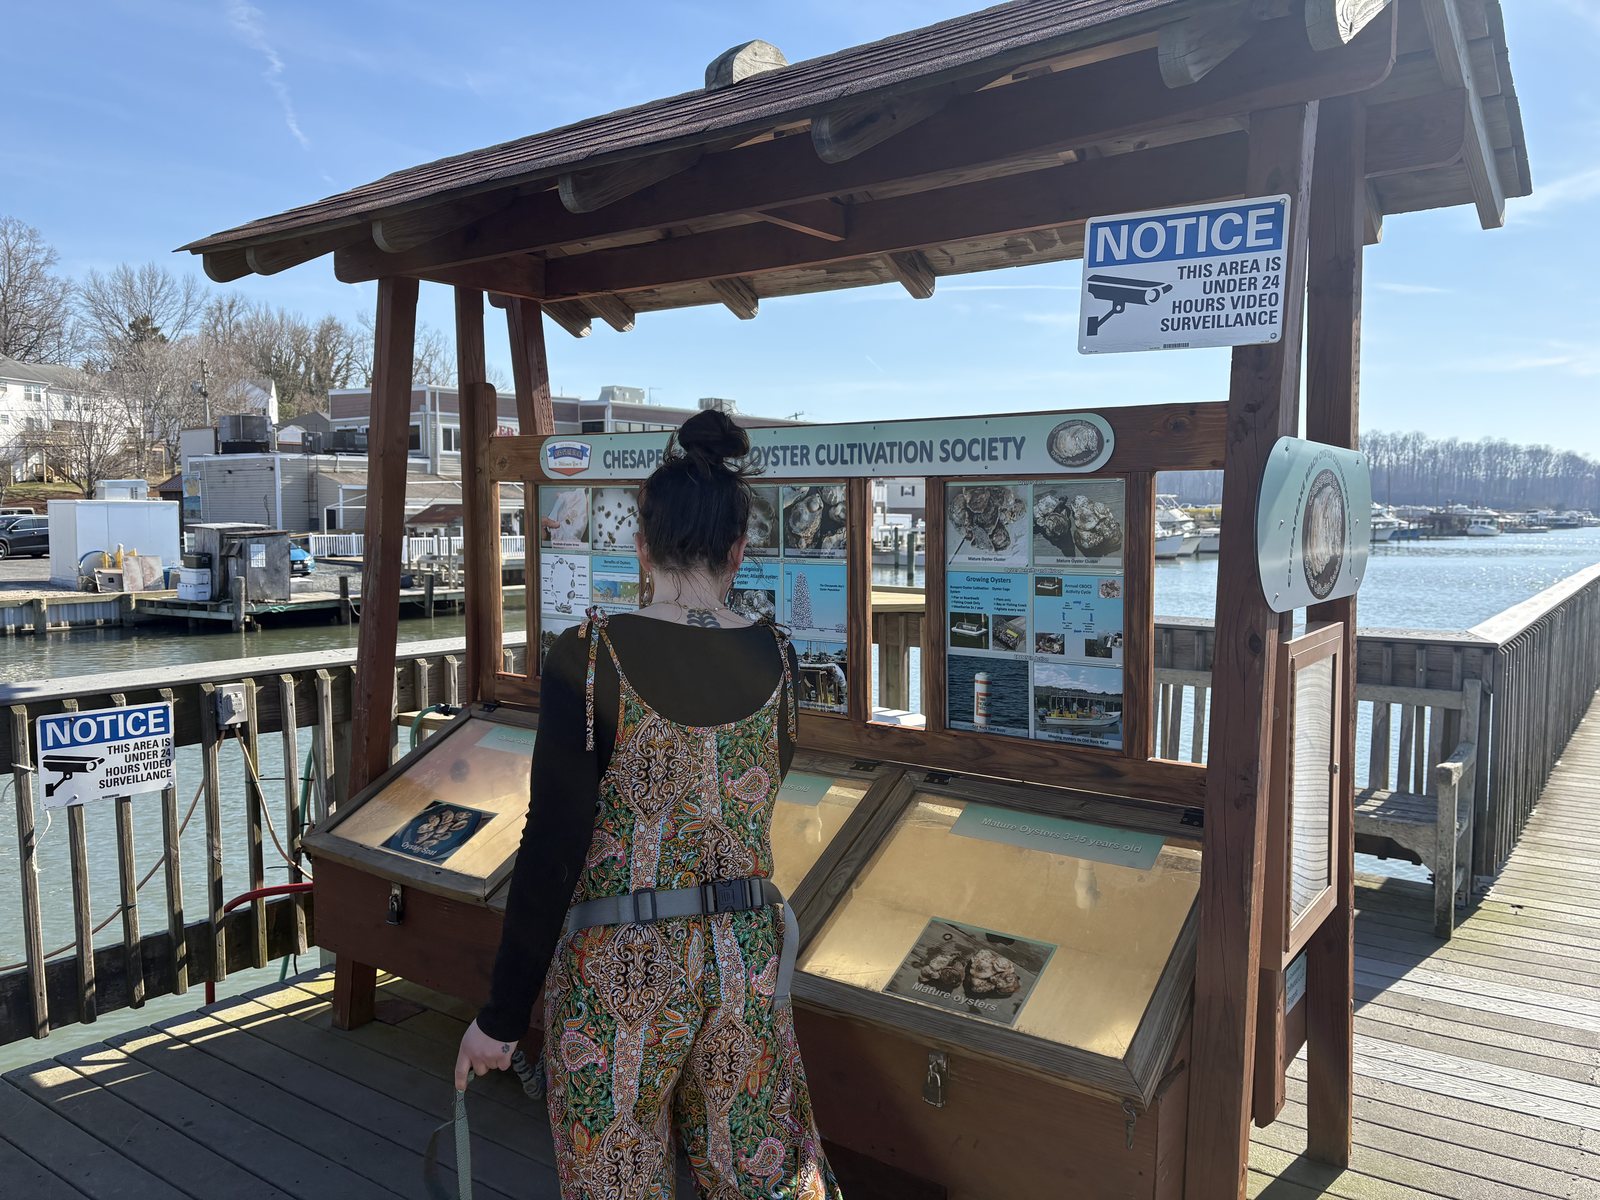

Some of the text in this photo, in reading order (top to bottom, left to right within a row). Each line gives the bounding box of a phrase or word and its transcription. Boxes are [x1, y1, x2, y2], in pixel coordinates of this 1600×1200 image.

[1095, 207, 1276, 263] NOTICE
[1177, 256, 1282, 280] THIS AREA IS
[1202, 274, 1280, 295] UNDER 24
[1172, 292, 1278, 314] HOURS VIDEO
[1160, 310, 1278, 332] SURVEILLANCE
[603, 449, 664, 470] CHESAPE
[750, 445, 811, 468] OYSTER
[815, 440, 934, 466] CULTIVATION
[940, 436, 1026, 462] SOCIETY
[966, 576, 1011, 584] Growing Oysters
[46, 709, 166, 747] NOTICE
[107, 738, 170, 755] THIS AREA IS
[124, 748, 171, 764] UNDER 24
[98, 769, 172, 789] SURVEILLANCE
[106, 758, 172, 778] HOURS VIDEO
[982, 816, 1143, 854] Mature Oysters 3-15 years old
[401, 841, 438, 856] Oyster Spat
[912, 982, 998, 1012] Mature oysters
